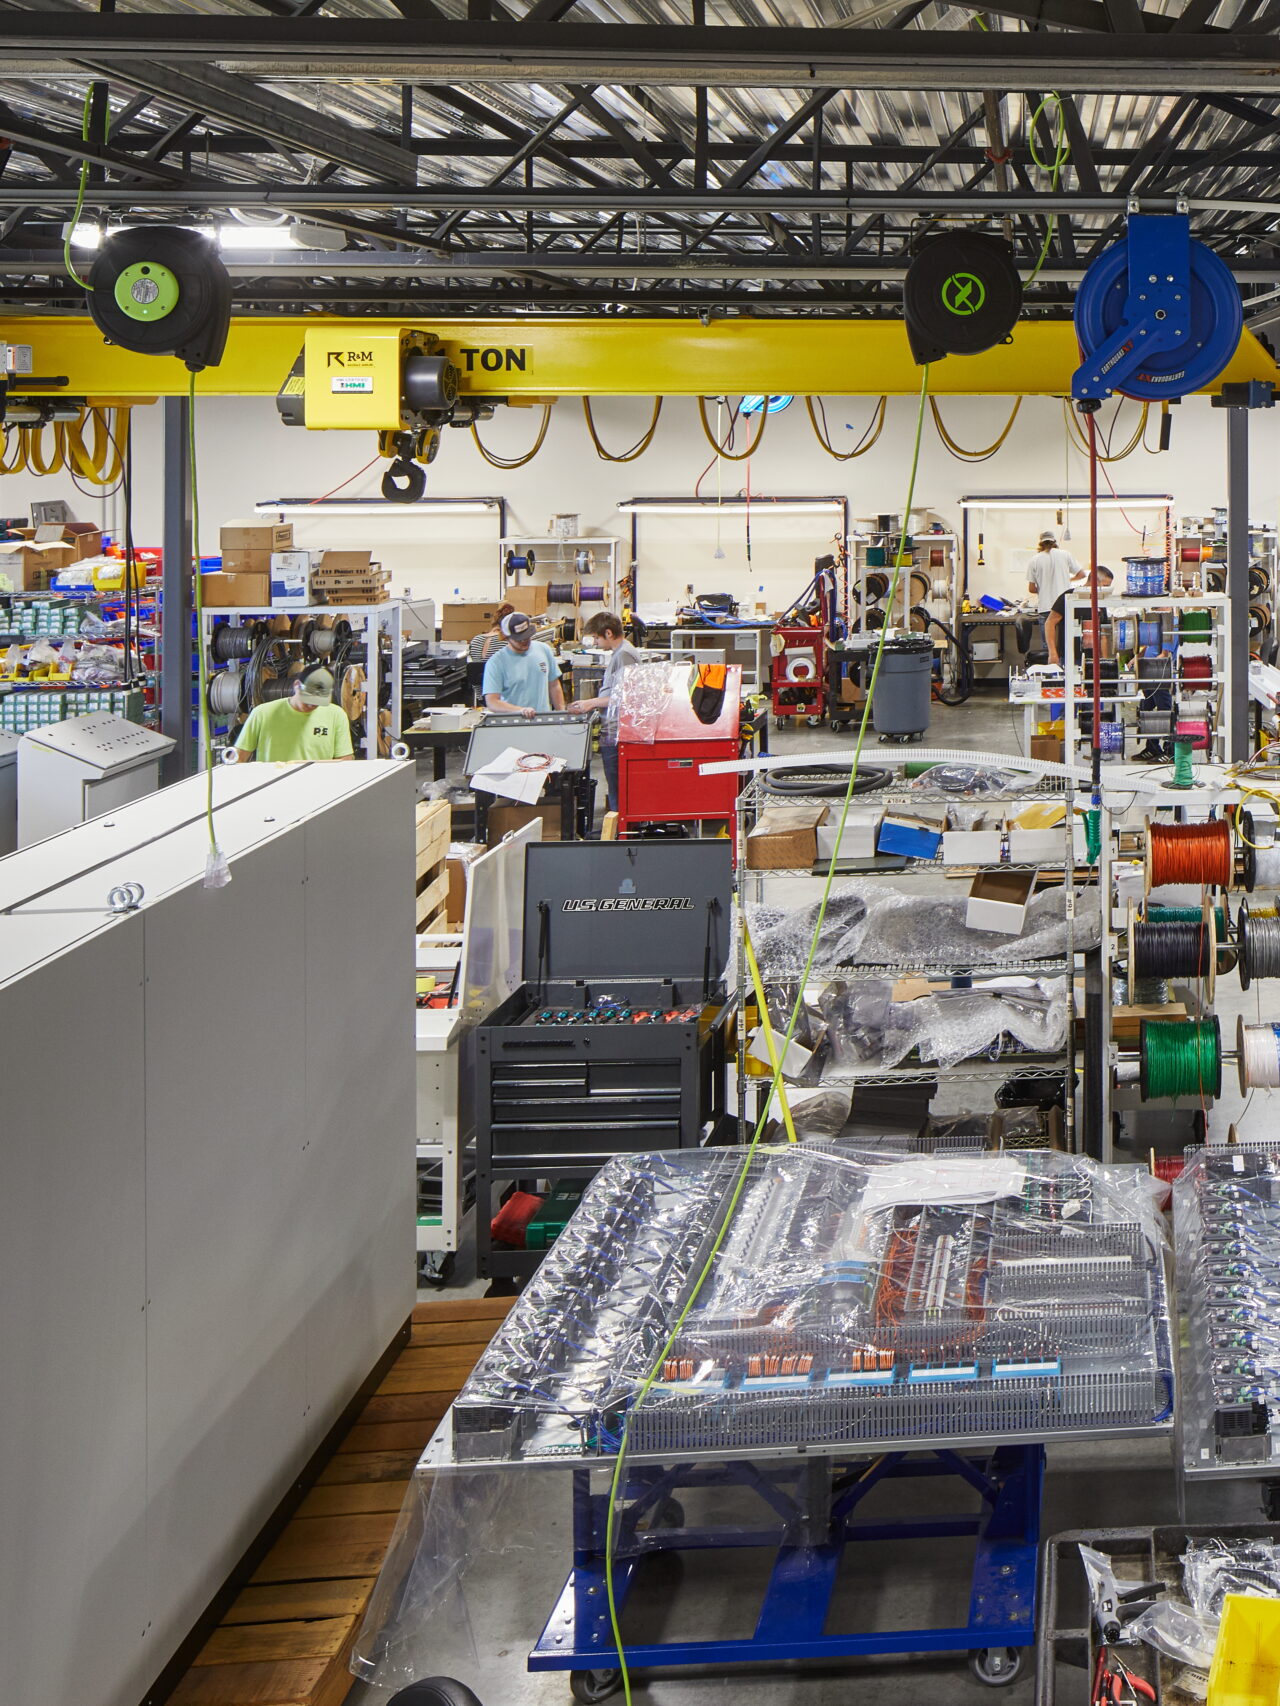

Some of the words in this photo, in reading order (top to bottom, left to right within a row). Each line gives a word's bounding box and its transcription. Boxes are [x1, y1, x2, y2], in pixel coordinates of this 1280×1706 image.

[347, 351, 373, 361] R&M
[460, 348, 526, 371] TON
[1101, 348, 1125, 375] EARTHQUAKE
[598, 898, 695, 911] GENERAL
